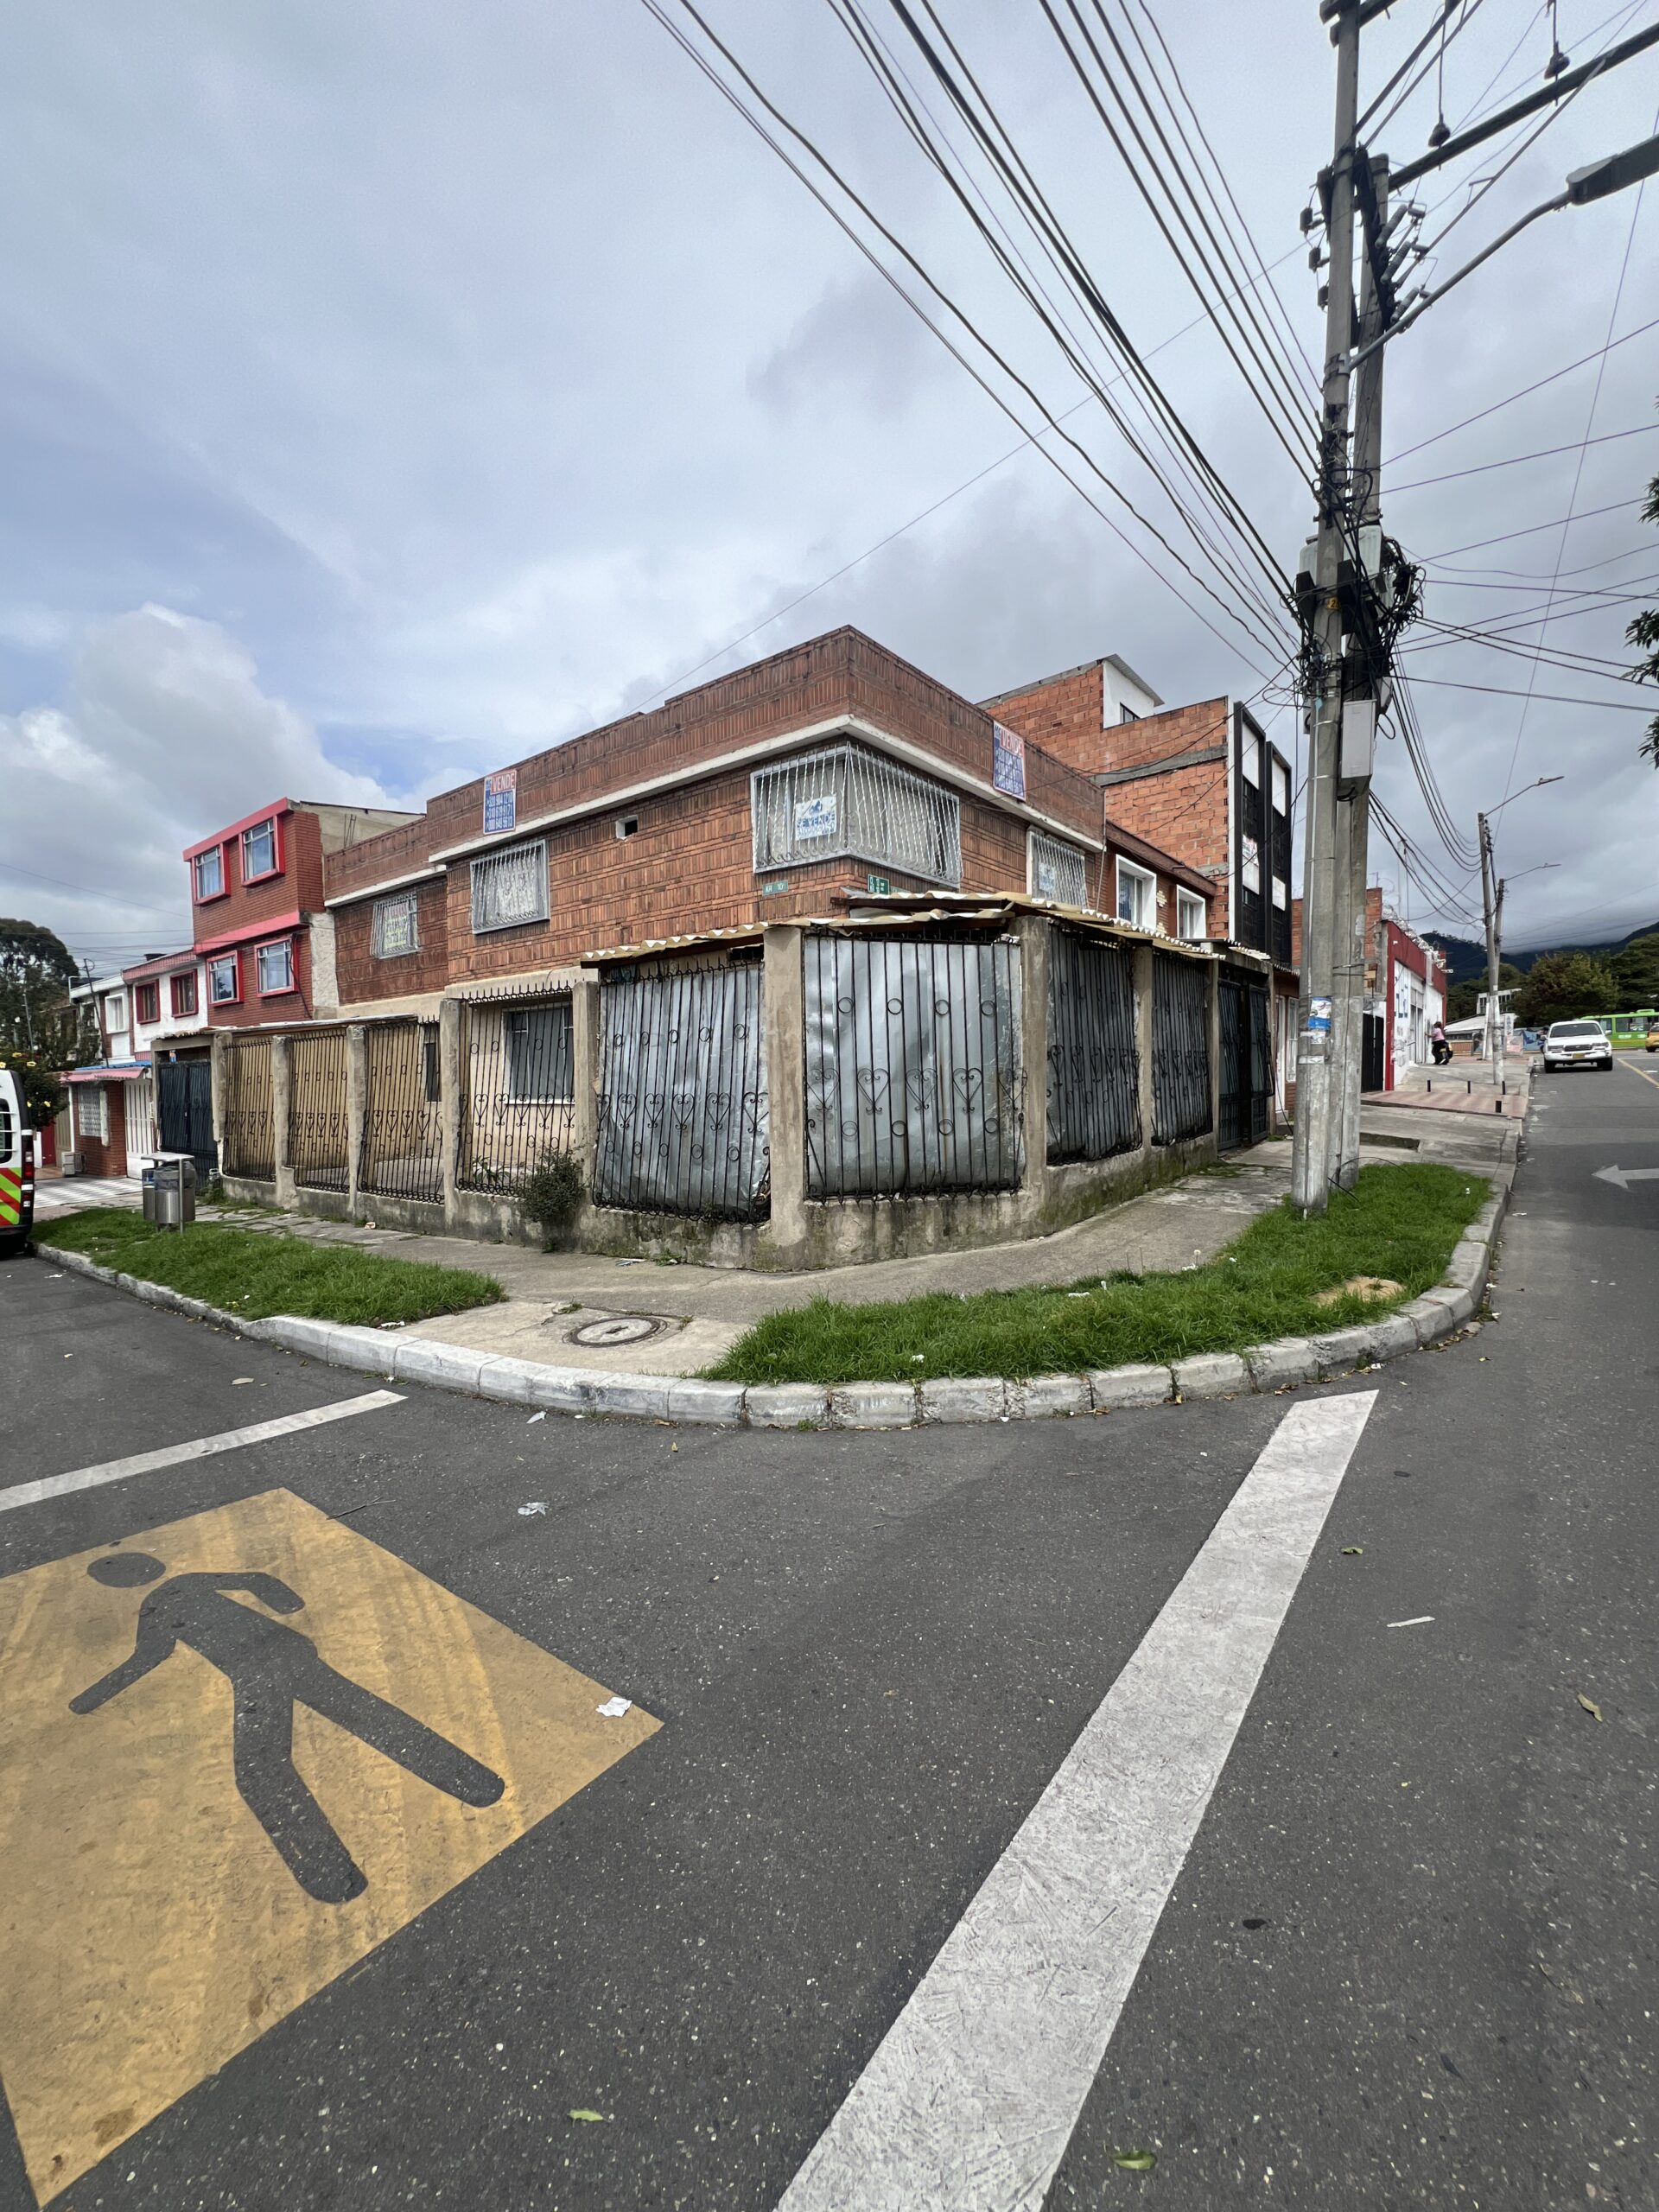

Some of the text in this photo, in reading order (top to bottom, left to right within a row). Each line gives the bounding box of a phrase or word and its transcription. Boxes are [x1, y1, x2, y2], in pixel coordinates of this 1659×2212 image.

[1002, 729, 1023, 757] VENDE
[493, 772, 516, 793] VENDE
[807, 811, 836, 828] VENDE
